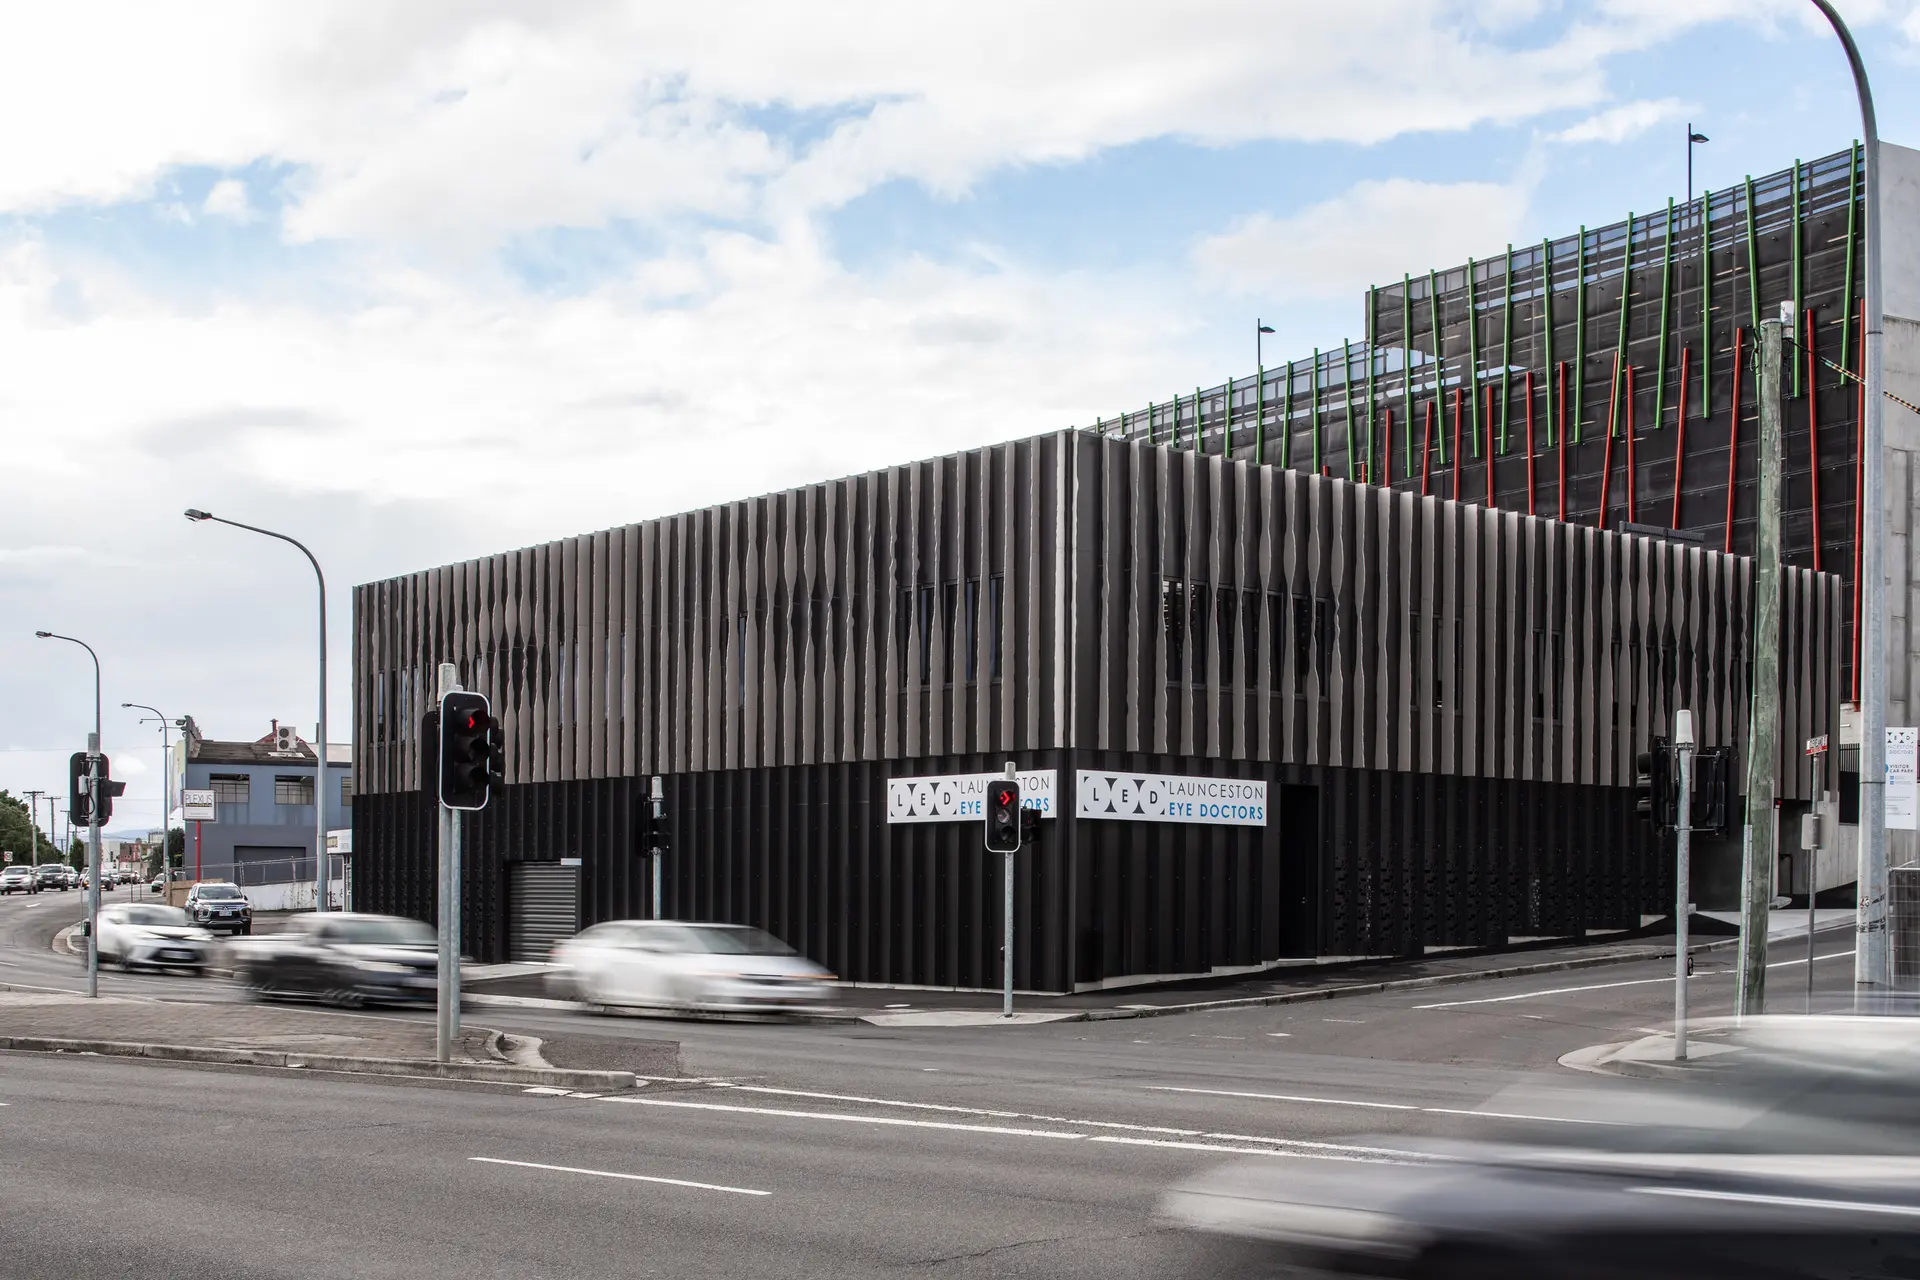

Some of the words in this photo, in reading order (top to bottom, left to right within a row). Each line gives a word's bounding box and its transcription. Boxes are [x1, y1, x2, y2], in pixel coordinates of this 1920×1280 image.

[960, 776, 1050, 795] LAUTON
[1169, 781, 1263, 800] LAUNCESTON
[960, 800, 981, 816] EYE
[1169, 802, 1192, 817] EYE
[1200, 804, 1263, 820] DOCTORS
